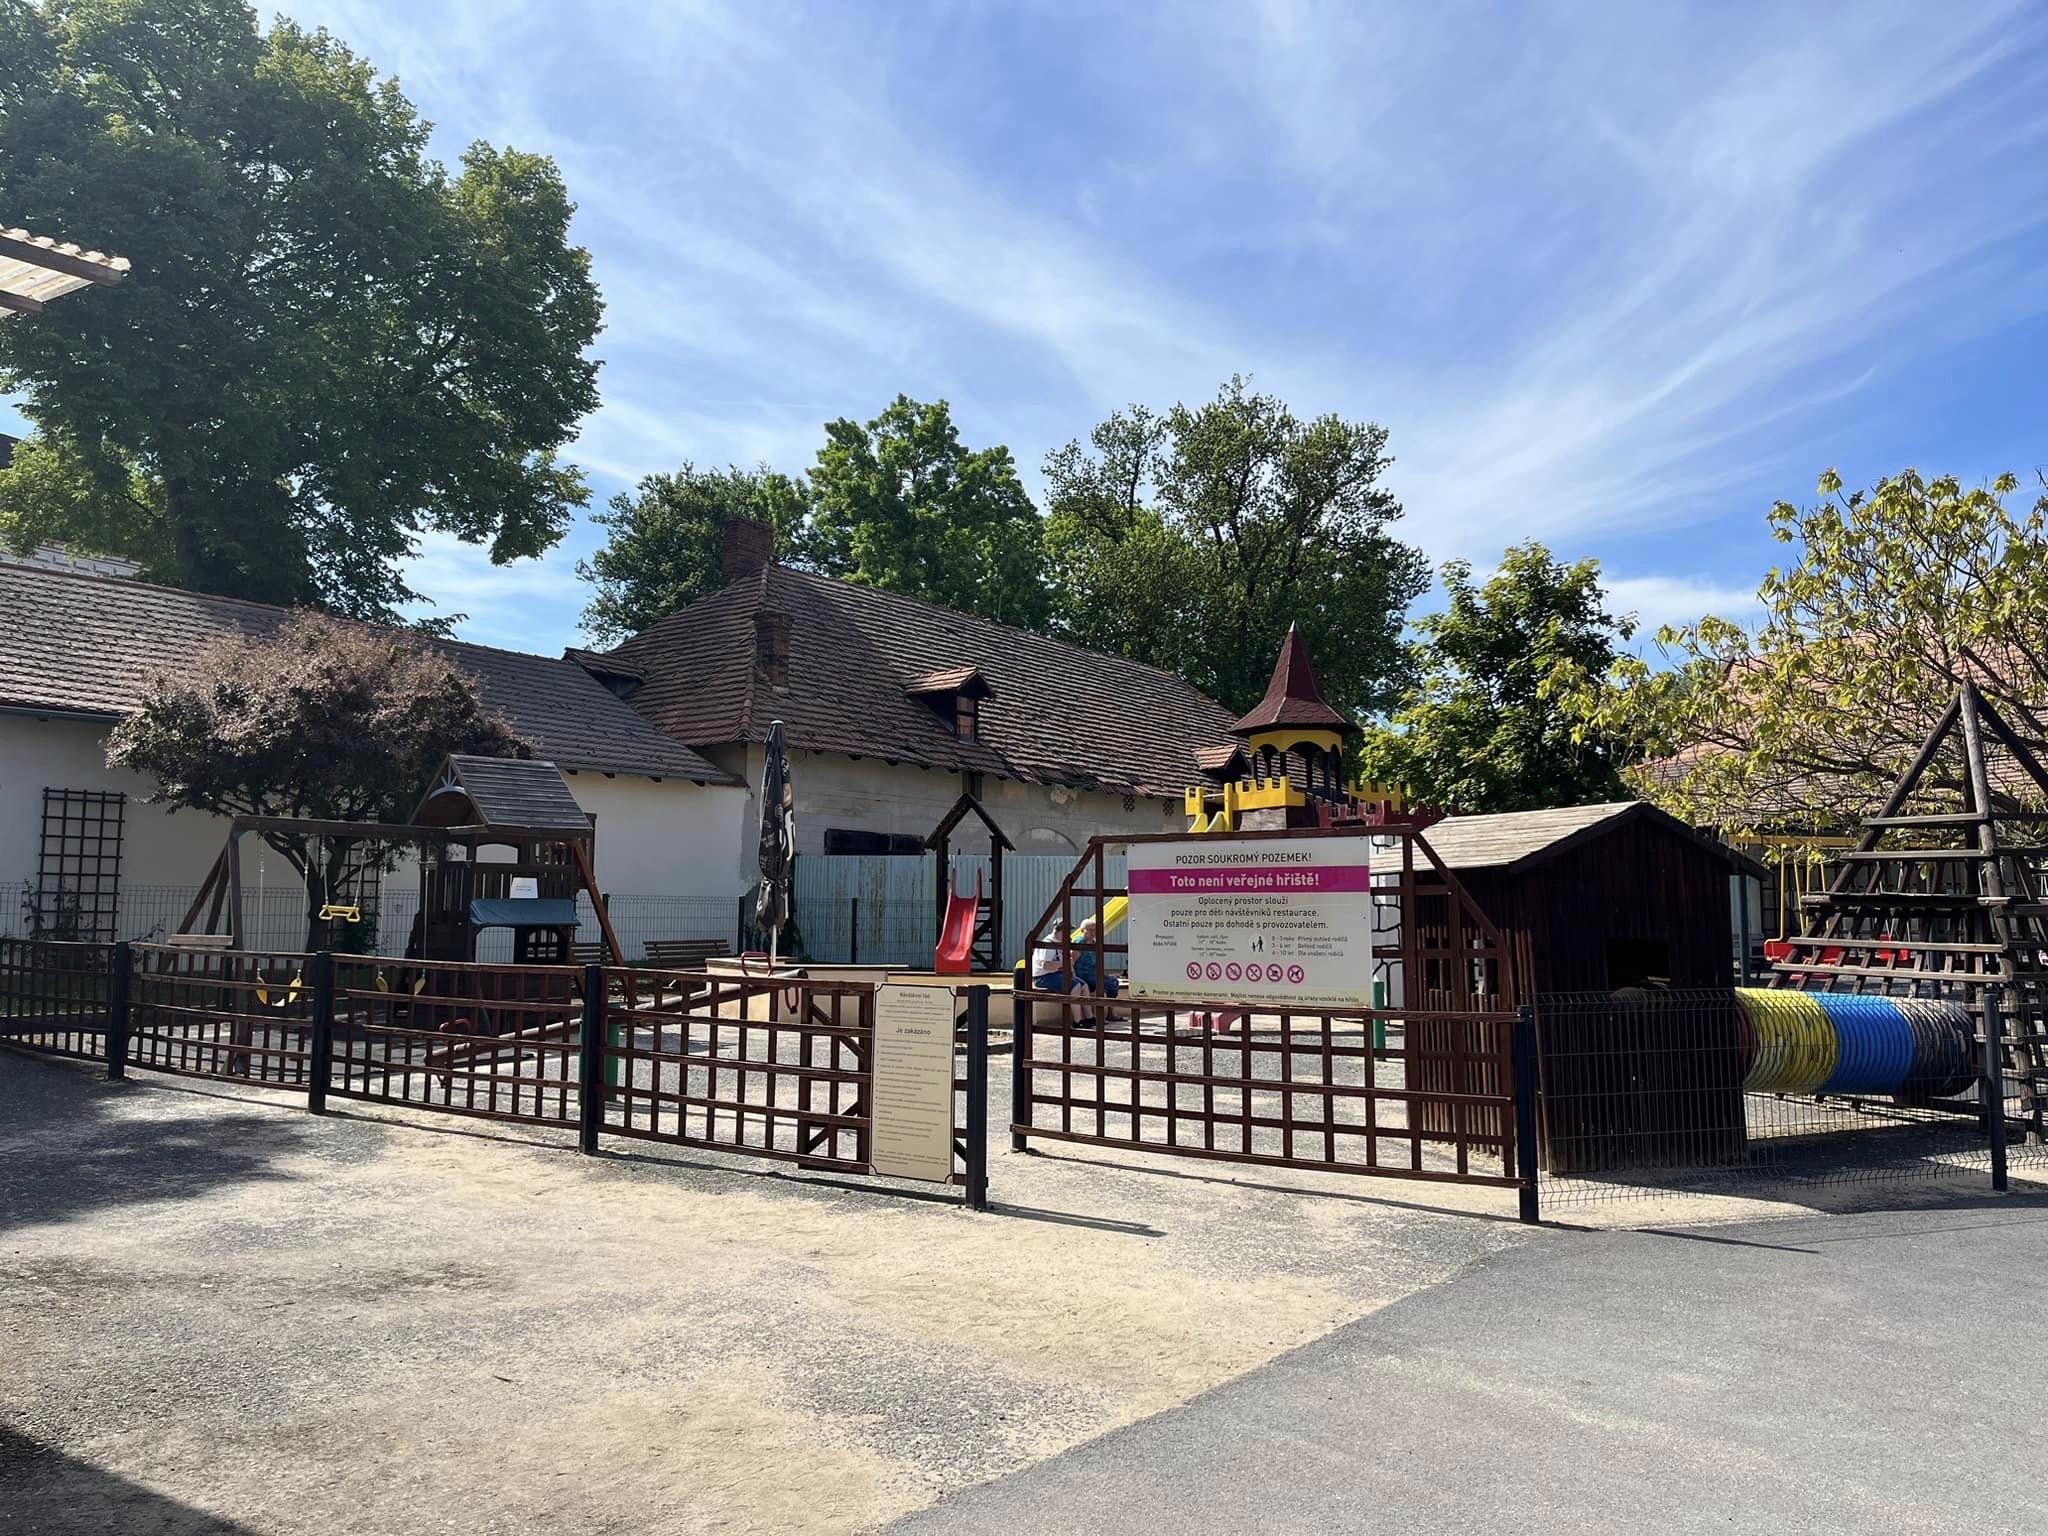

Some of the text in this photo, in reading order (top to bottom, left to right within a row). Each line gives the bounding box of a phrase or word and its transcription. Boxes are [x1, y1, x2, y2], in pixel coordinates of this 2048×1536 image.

[1176, 851, 1312, 865] POZOR SOUKROMÝ POZEMEK!
[1170, 875, 1196, 887] Toto
[1226, 872, 1273, 889] veřejné
[1276, 871, 1319, 886] hřiště!
[1198, 896, 1232, 907] Oplocený
[1234, 897, 1262, 907] prostor
[1171, 909, 1192, 917] pouze
[1194, 909, 1207, 917] pro
[1273, 909, 1320, 917] restaurace.
[1191, 920, 1213, 929] pouze
[1214, 921, 1224, 929] po
[1262, 920, 1329, 930] provozovatelem.
